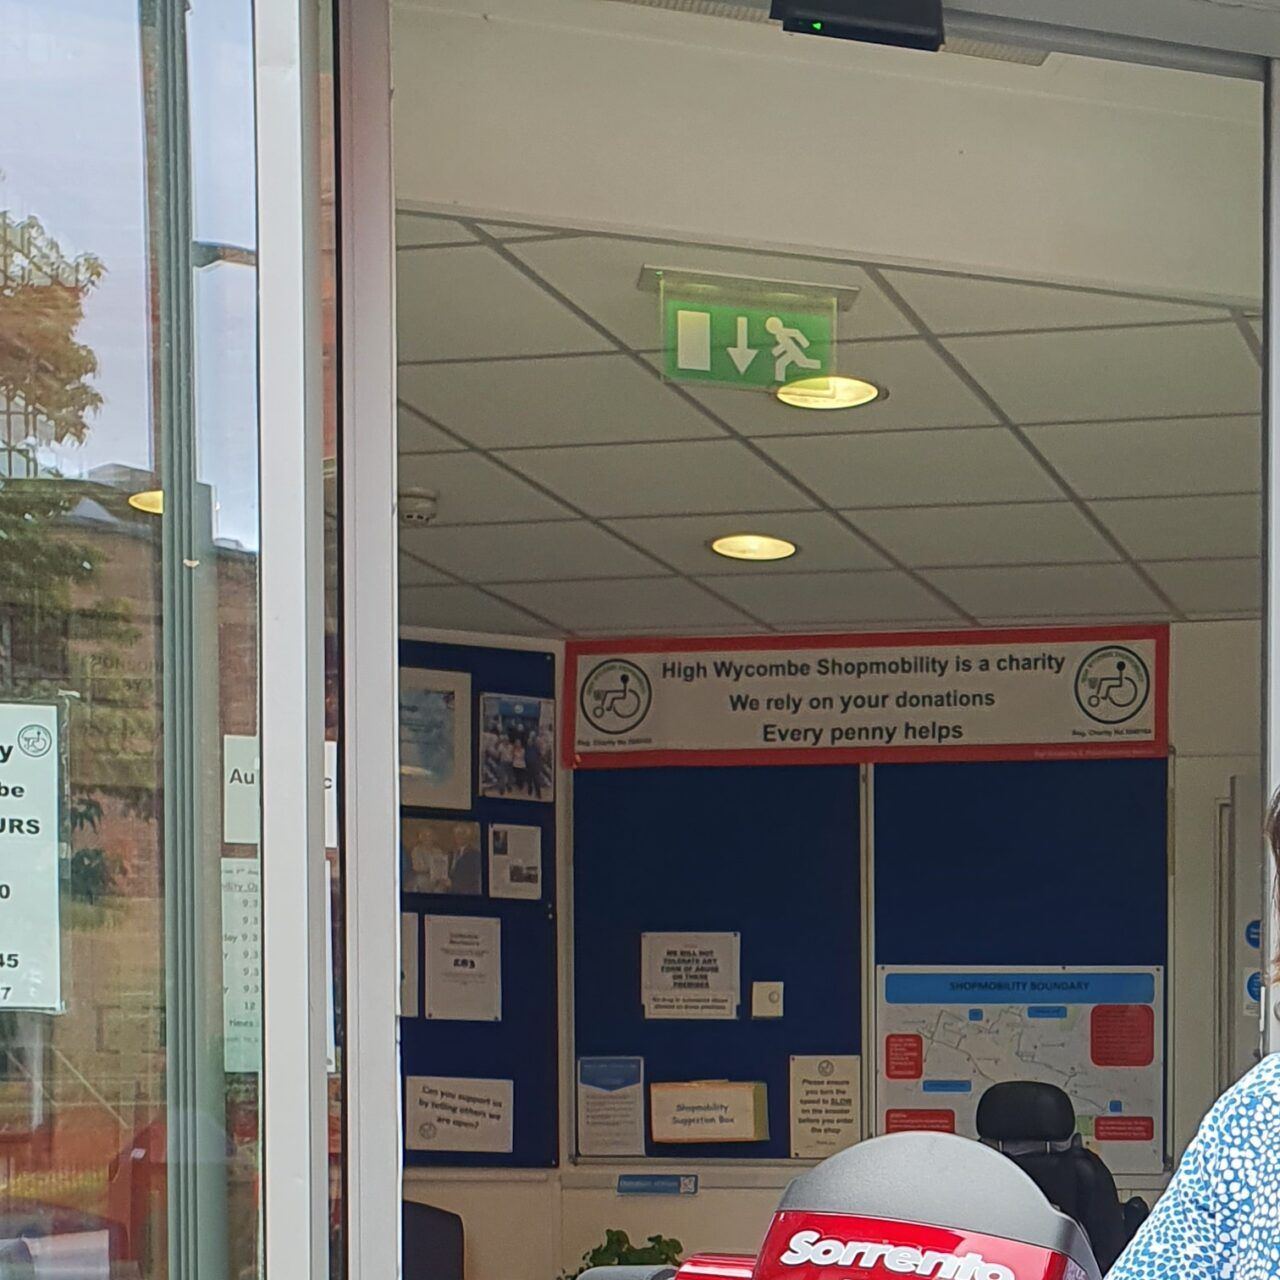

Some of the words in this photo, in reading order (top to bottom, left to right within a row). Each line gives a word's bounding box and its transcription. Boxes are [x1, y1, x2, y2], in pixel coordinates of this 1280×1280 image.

[661, 661, 707, 681] High
[713, 660, 810, 680] Wycombe
[816, 655, 949, 678] Shopmobility
[955, 656, 972, 672] is
[978, 658, 990, 671] a
[996, 653, 1066, 674] charity
[729, 694, 759, 711] We
[766, 694, 802, 714] rely
[809, 695, 834, 709] on
[840, 694, 888, 714] your
[895, 690, 995, 708] donations
[763, 724, 824, 745] Every
[830, 724, 897, 744] penny
[903, 722, 964, 741] helps
[949, 981, 1027, 993] SHOPMOBILITY
[1030, 981, 1090, 992] BOUNDARY
[422, 1085, 438, 1095] Can
[440, 1090, 456, 1100] you
[458, 1093, 491, 1105] support
[492, 1100, 502, 1108] us
[418, 1097, 429, 1108] by
[431, 1101, 458, 1114] telling
[459, 1107, 486, 1118] others
[488, 1112, 501, 1121] we
[672, 1115, 716, 1126] Suggestion
[718, 1115, 735, 1124] Box
[676, 1104, 729, 1114] Shopmobility
[437, 1116, 450, 1125] are
[452, 1119, 479, 1129] open?
